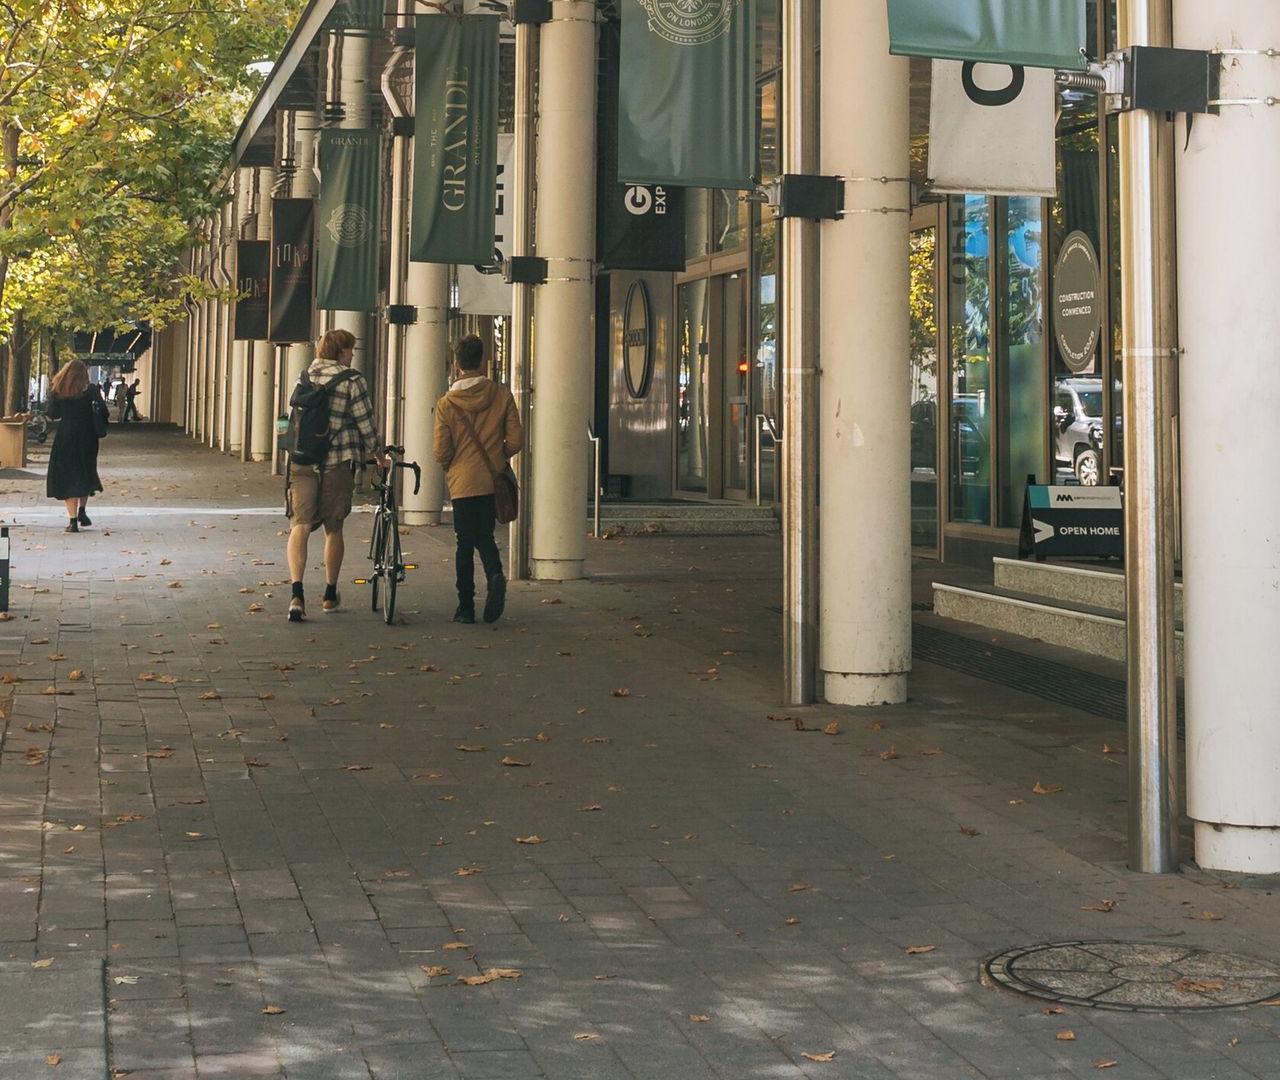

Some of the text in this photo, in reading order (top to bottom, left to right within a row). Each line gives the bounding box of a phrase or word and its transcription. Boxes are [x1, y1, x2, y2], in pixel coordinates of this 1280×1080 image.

[666, 10, 714, 27] ON LONDON
[624, 183, 652, 216] G
[1059, 290, 1095, 303] CONSTRUCTION
[1062, 305, 1092, 317] COMMENCED
[1060, 526, 1120, 536] OPEN HOME
